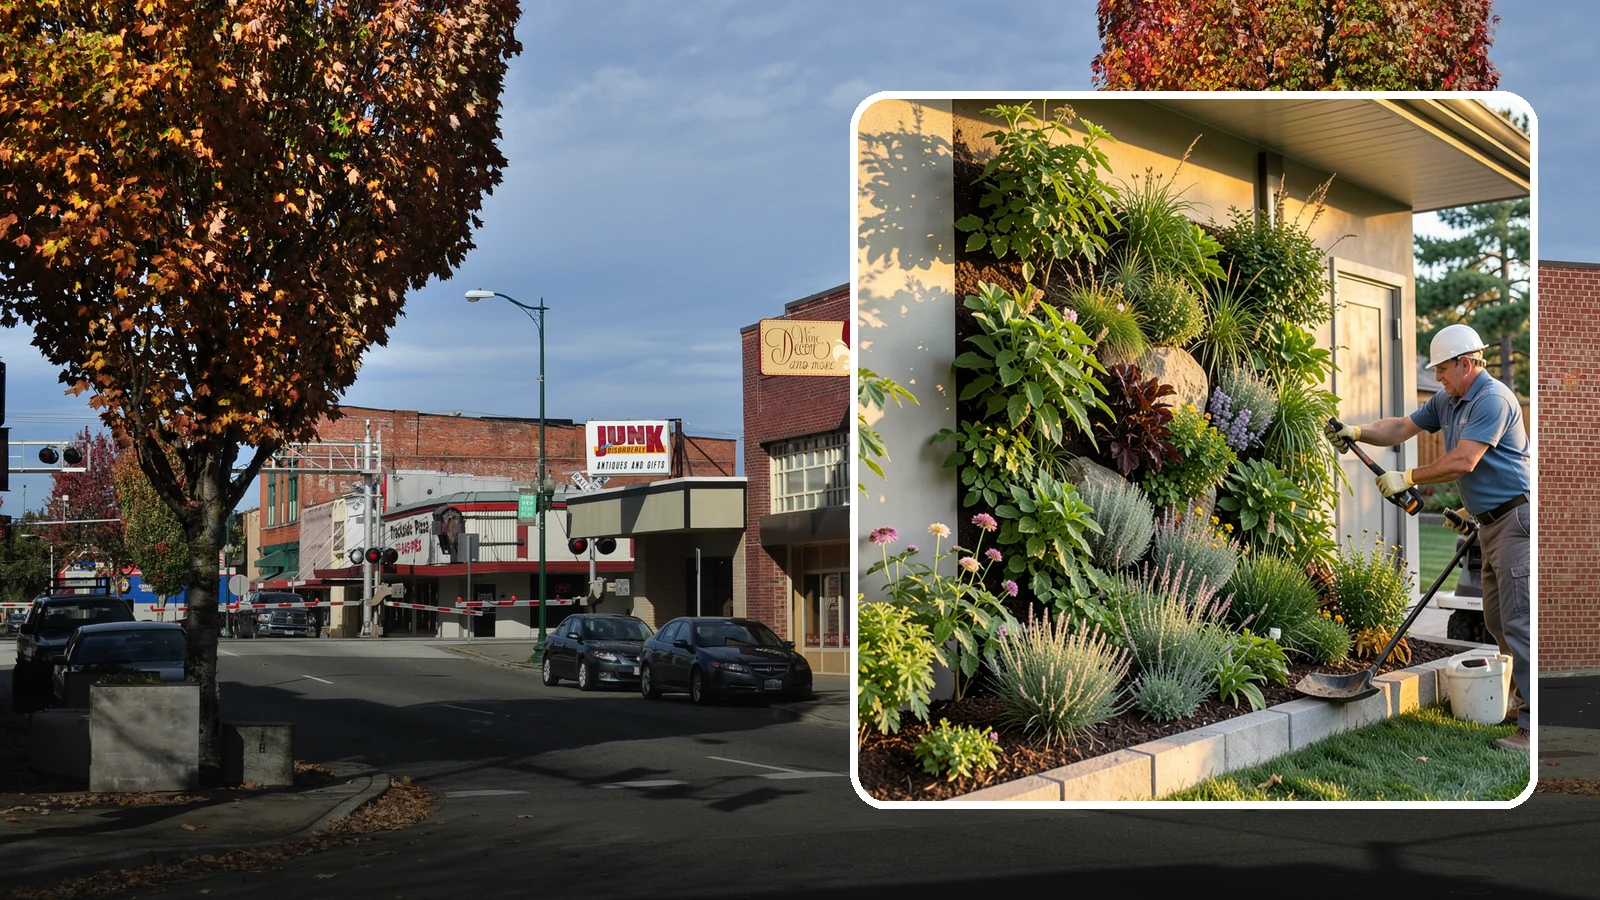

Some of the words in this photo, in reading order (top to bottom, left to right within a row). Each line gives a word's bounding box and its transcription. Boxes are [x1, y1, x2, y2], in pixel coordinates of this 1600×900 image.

[595, 425, 664, 457] JUNK
[607, 446, 646, 454] DISORDERLY
[597, 461, 628, 470] ANTIQUES
[631, 461, 644, 470] AND
[647, 460, 665, 469] GIFTS
[390, 521, 413, 540] Trackside
[414, 519, 429, 534] Pizza
